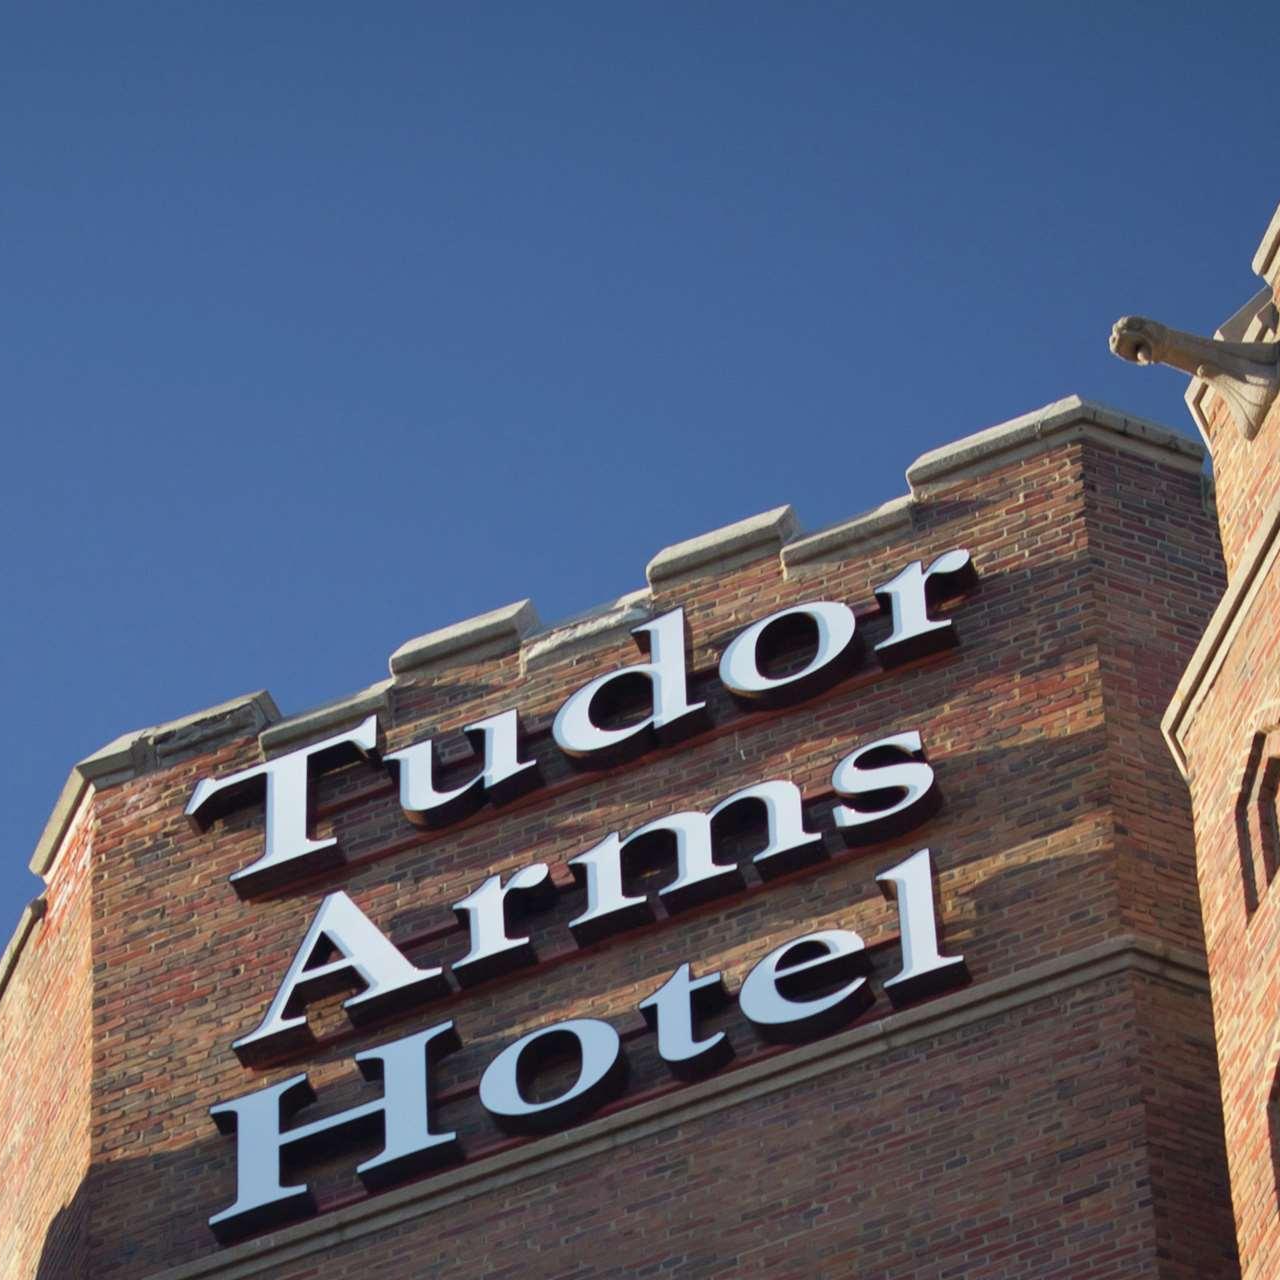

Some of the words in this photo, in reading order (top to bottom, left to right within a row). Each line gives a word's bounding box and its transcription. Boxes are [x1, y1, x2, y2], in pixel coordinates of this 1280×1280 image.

[182, 548, 972, 884] Tudor
[208, 848, 964, 1227] Hotel
[232, 730, 935, 1050] Arms
